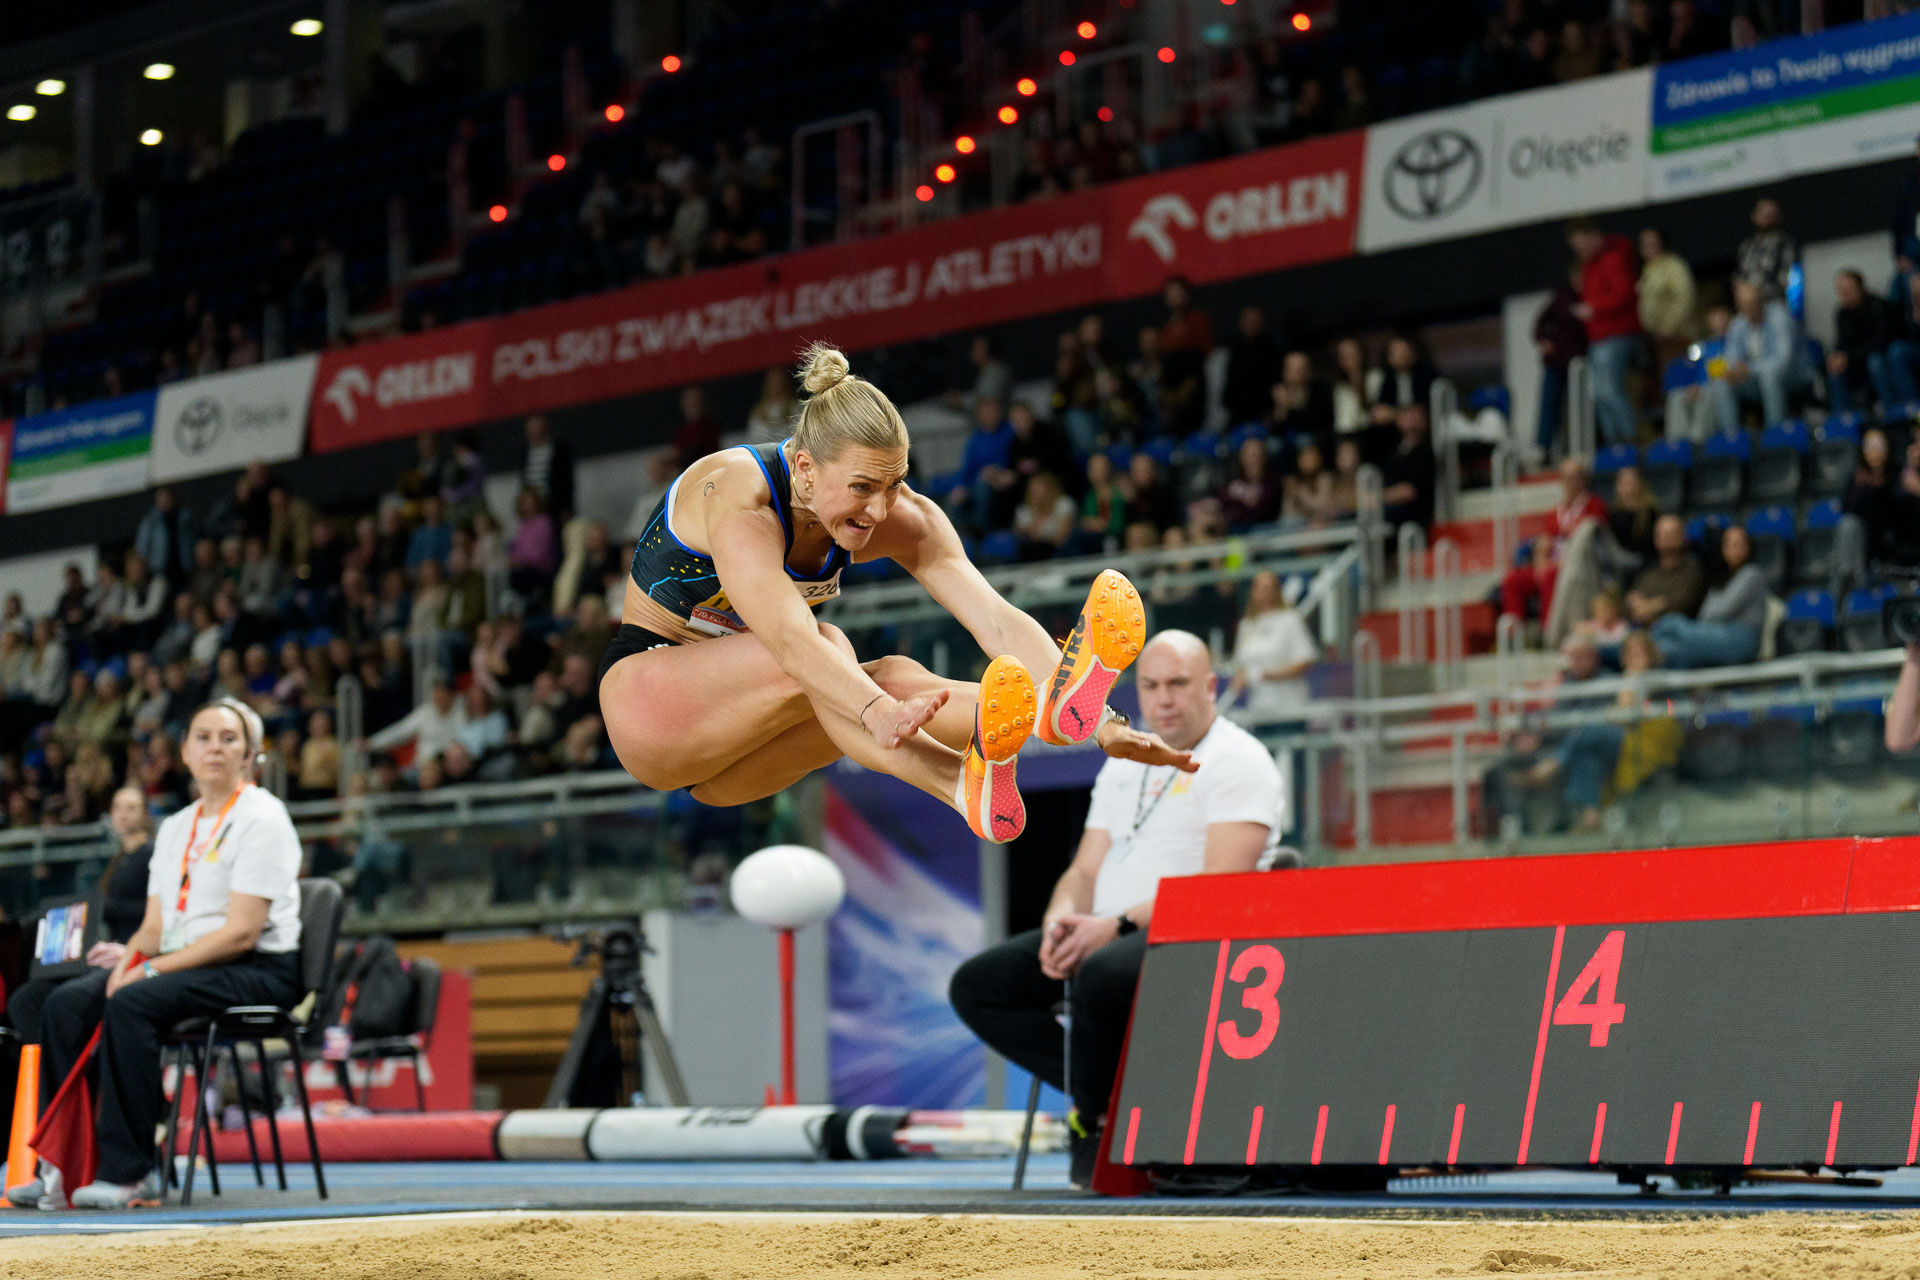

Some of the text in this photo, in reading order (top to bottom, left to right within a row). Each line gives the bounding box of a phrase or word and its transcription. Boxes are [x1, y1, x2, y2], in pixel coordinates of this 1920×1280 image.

[1204, 171, 1349, 241] ORLEN
[492, 223, 1102, 384] POLSKI ZWIĄZEK LEKKIEJ ATLETYKI
[375, 352, 476, 408] ORLEN
[1049, 614, 1085, 704] NITRO
[1217, 930, 1626, 1059] 3 4
